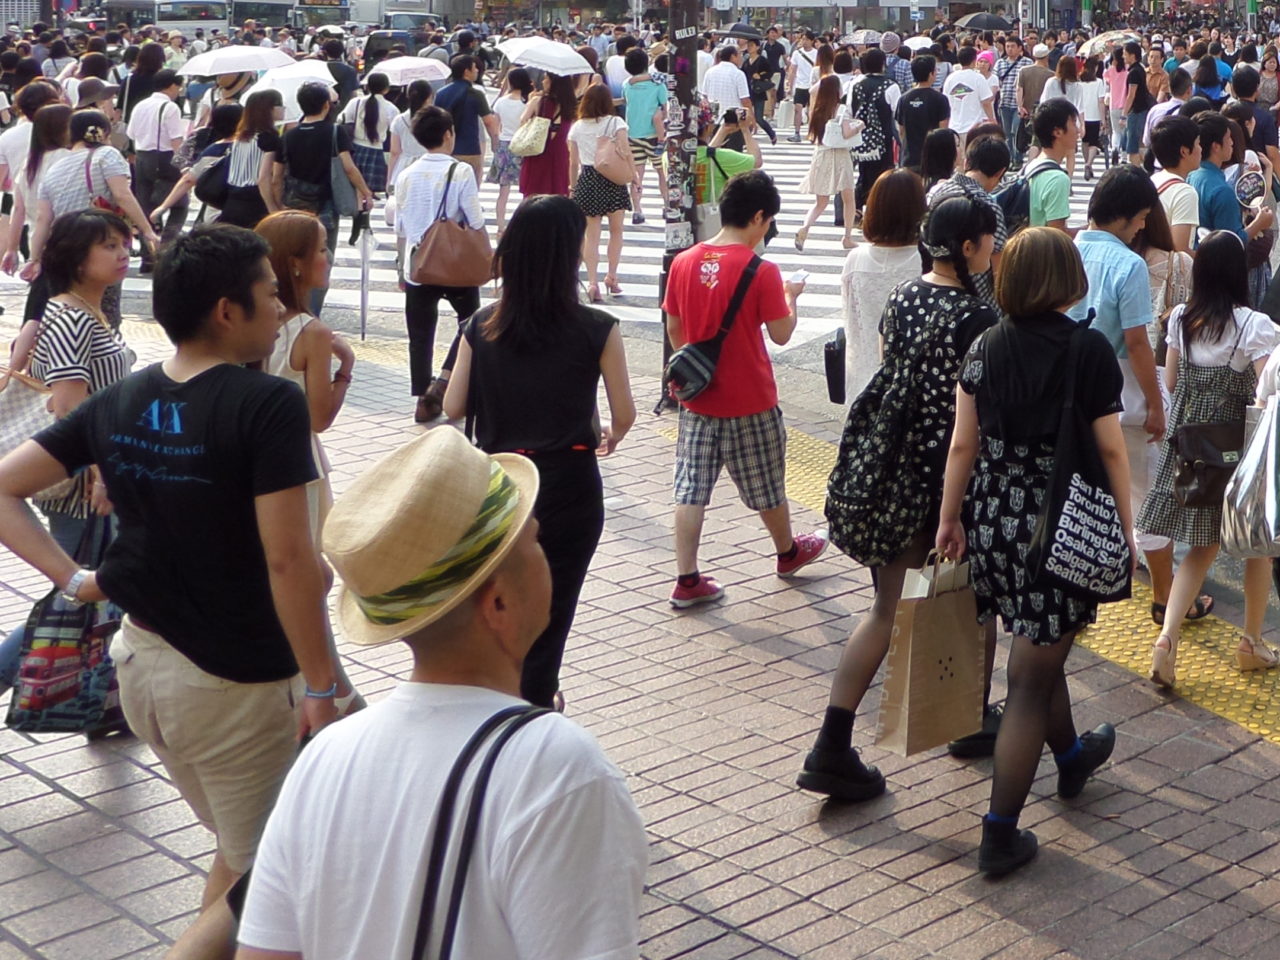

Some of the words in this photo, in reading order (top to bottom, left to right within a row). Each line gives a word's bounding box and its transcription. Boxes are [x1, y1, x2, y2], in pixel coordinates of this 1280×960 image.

[675, 27, 695, 39] RULER
[1071, 473, 1092, 497] San
[1045, 557, 1088, 588] Seattle
